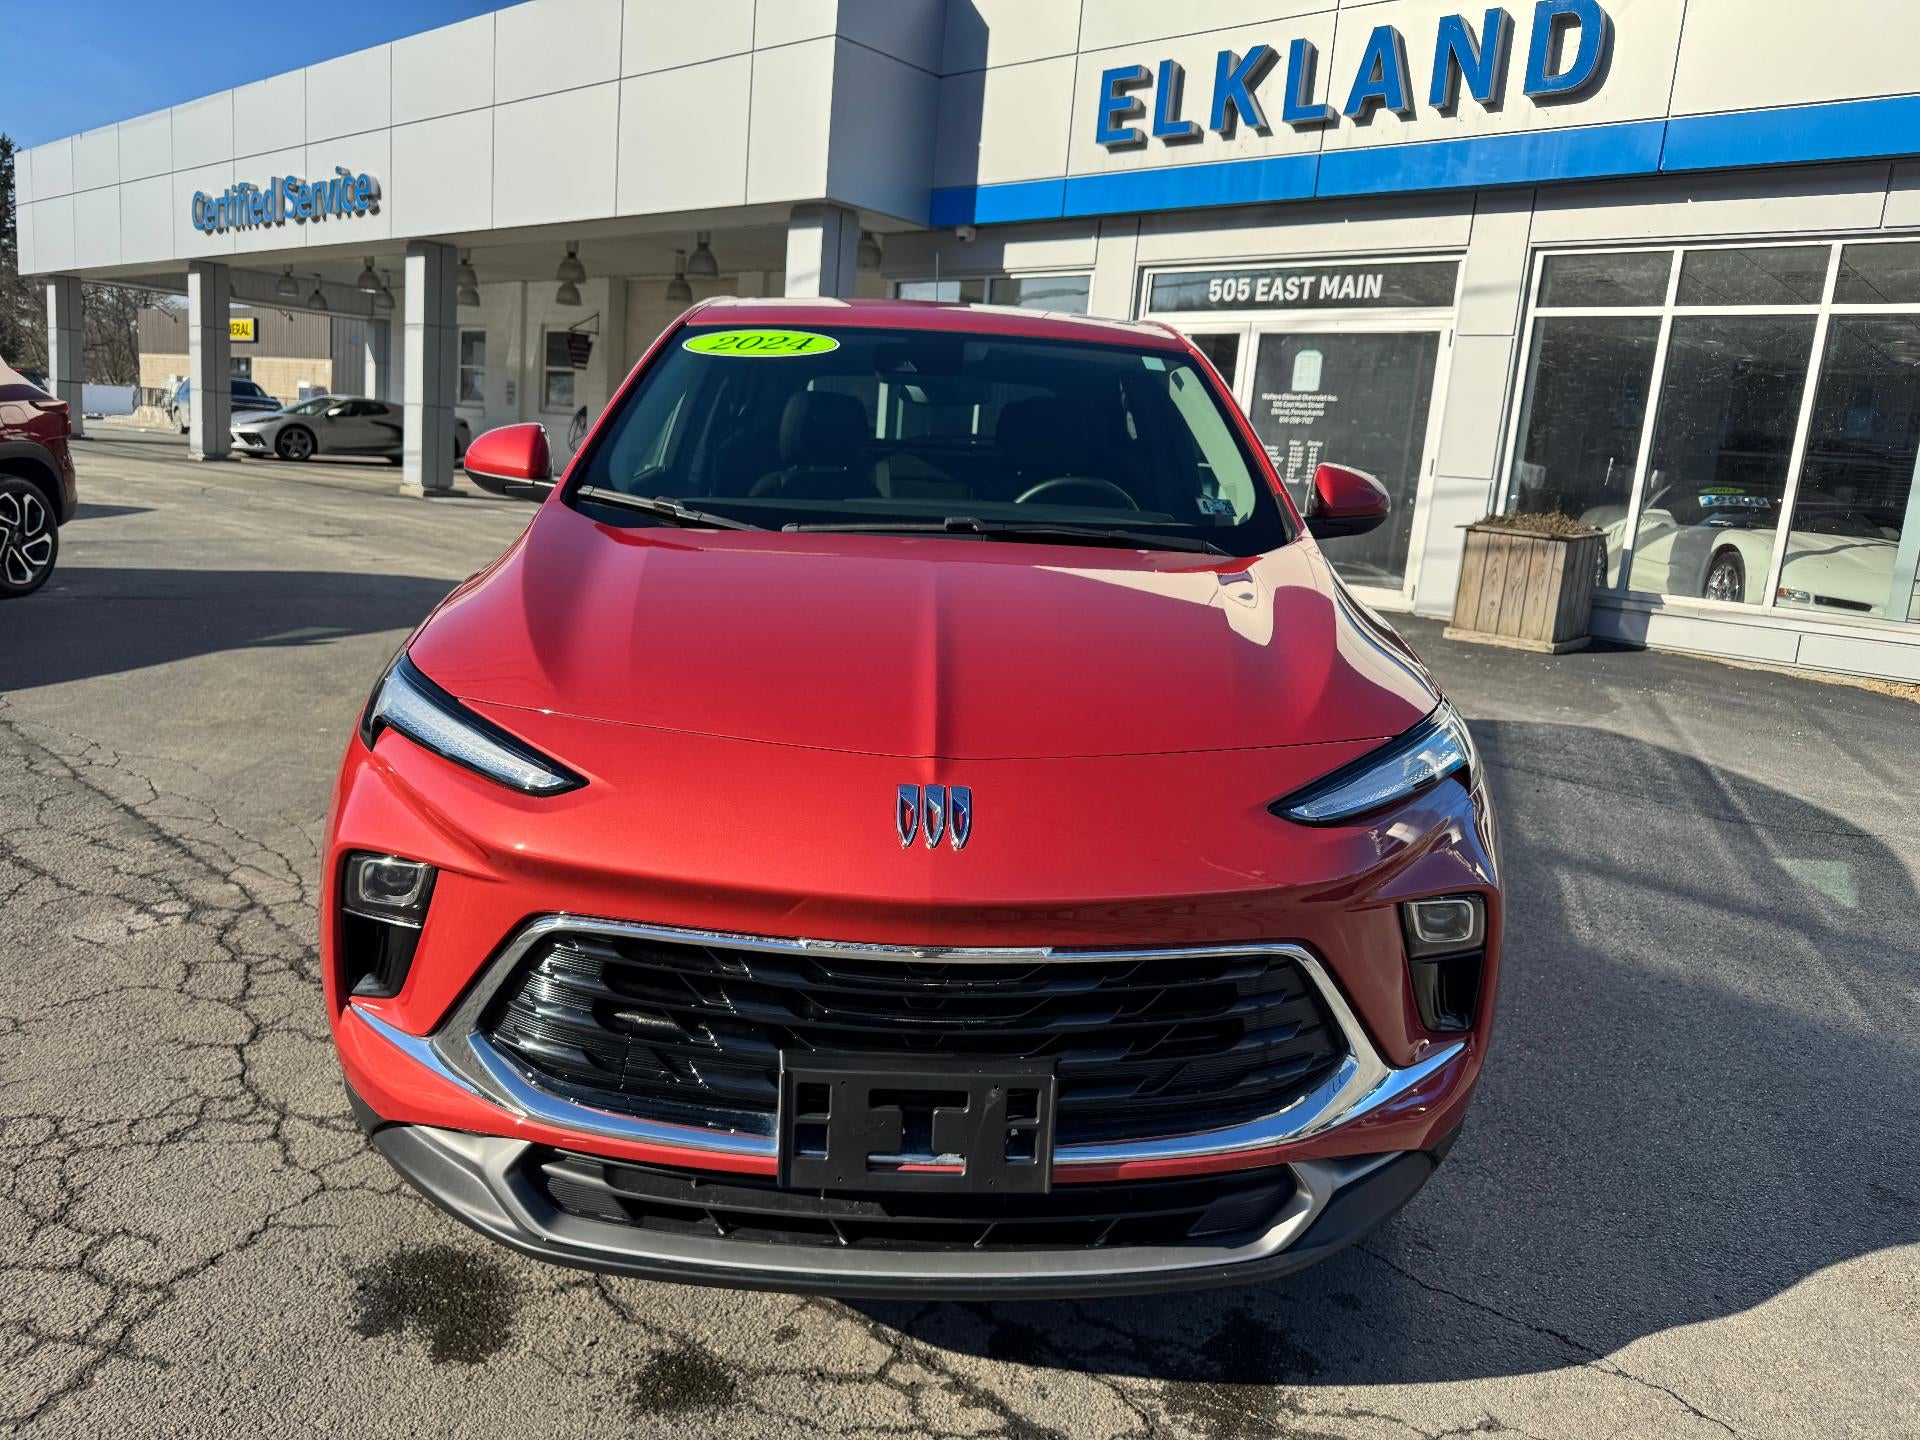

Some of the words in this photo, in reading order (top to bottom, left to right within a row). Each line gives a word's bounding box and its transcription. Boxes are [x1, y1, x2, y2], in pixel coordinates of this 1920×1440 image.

[1096, 0, 1609, 149] ELKLAND
[192, 176, 278, 232] Certified
[283, 166, 374, 219] Service
[1208, 278, 1251, 302] 505
[1255, 276, 1316, 302] EAST
[1319, 274, 1383, 300] MAIN
[229, 322, 250, 336] ERAL
[708, 336, 816, 351] 2024
